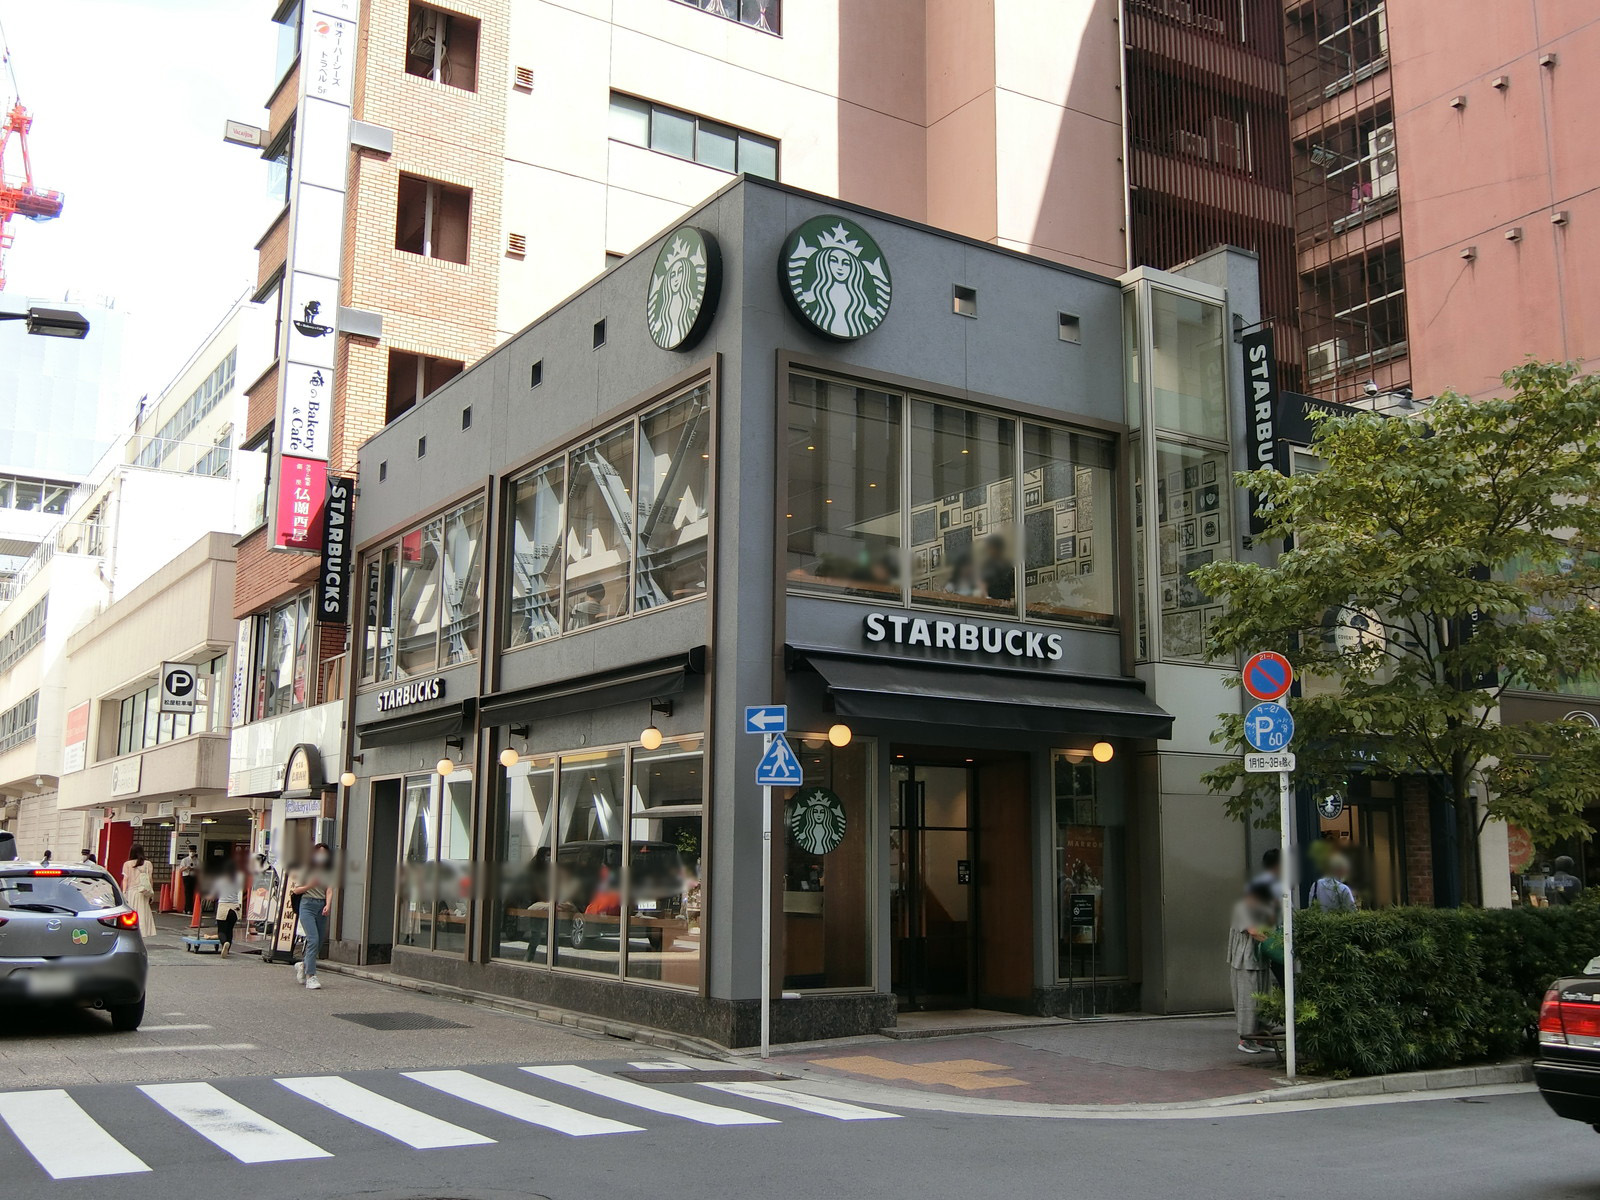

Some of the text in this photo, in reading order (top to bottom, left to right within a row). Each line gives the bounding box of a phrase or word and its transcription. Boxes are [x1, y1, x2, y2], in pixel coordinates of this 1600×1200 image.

[292, 406, 302, 415] &
[303, 400, 321, 453] Bakery
[289, 417, 304, 451] Cafe
[1249, 344, 1275, 518] STARBU
[323, 485, 348, 614] STARBUCKS
[866, 612, 1064, 661] STARBUCKS
[171, 673, 191, 693] P
[377, 678, 440, 711] STARBUCKS
[1257, 705, 1280, 714] 9-21
[1255, 716, 1275, 747] P
[1268, 732, 1283, 746] 60
[132, 815, 142, 826] 2
[181, 810, 189, 822] 3
